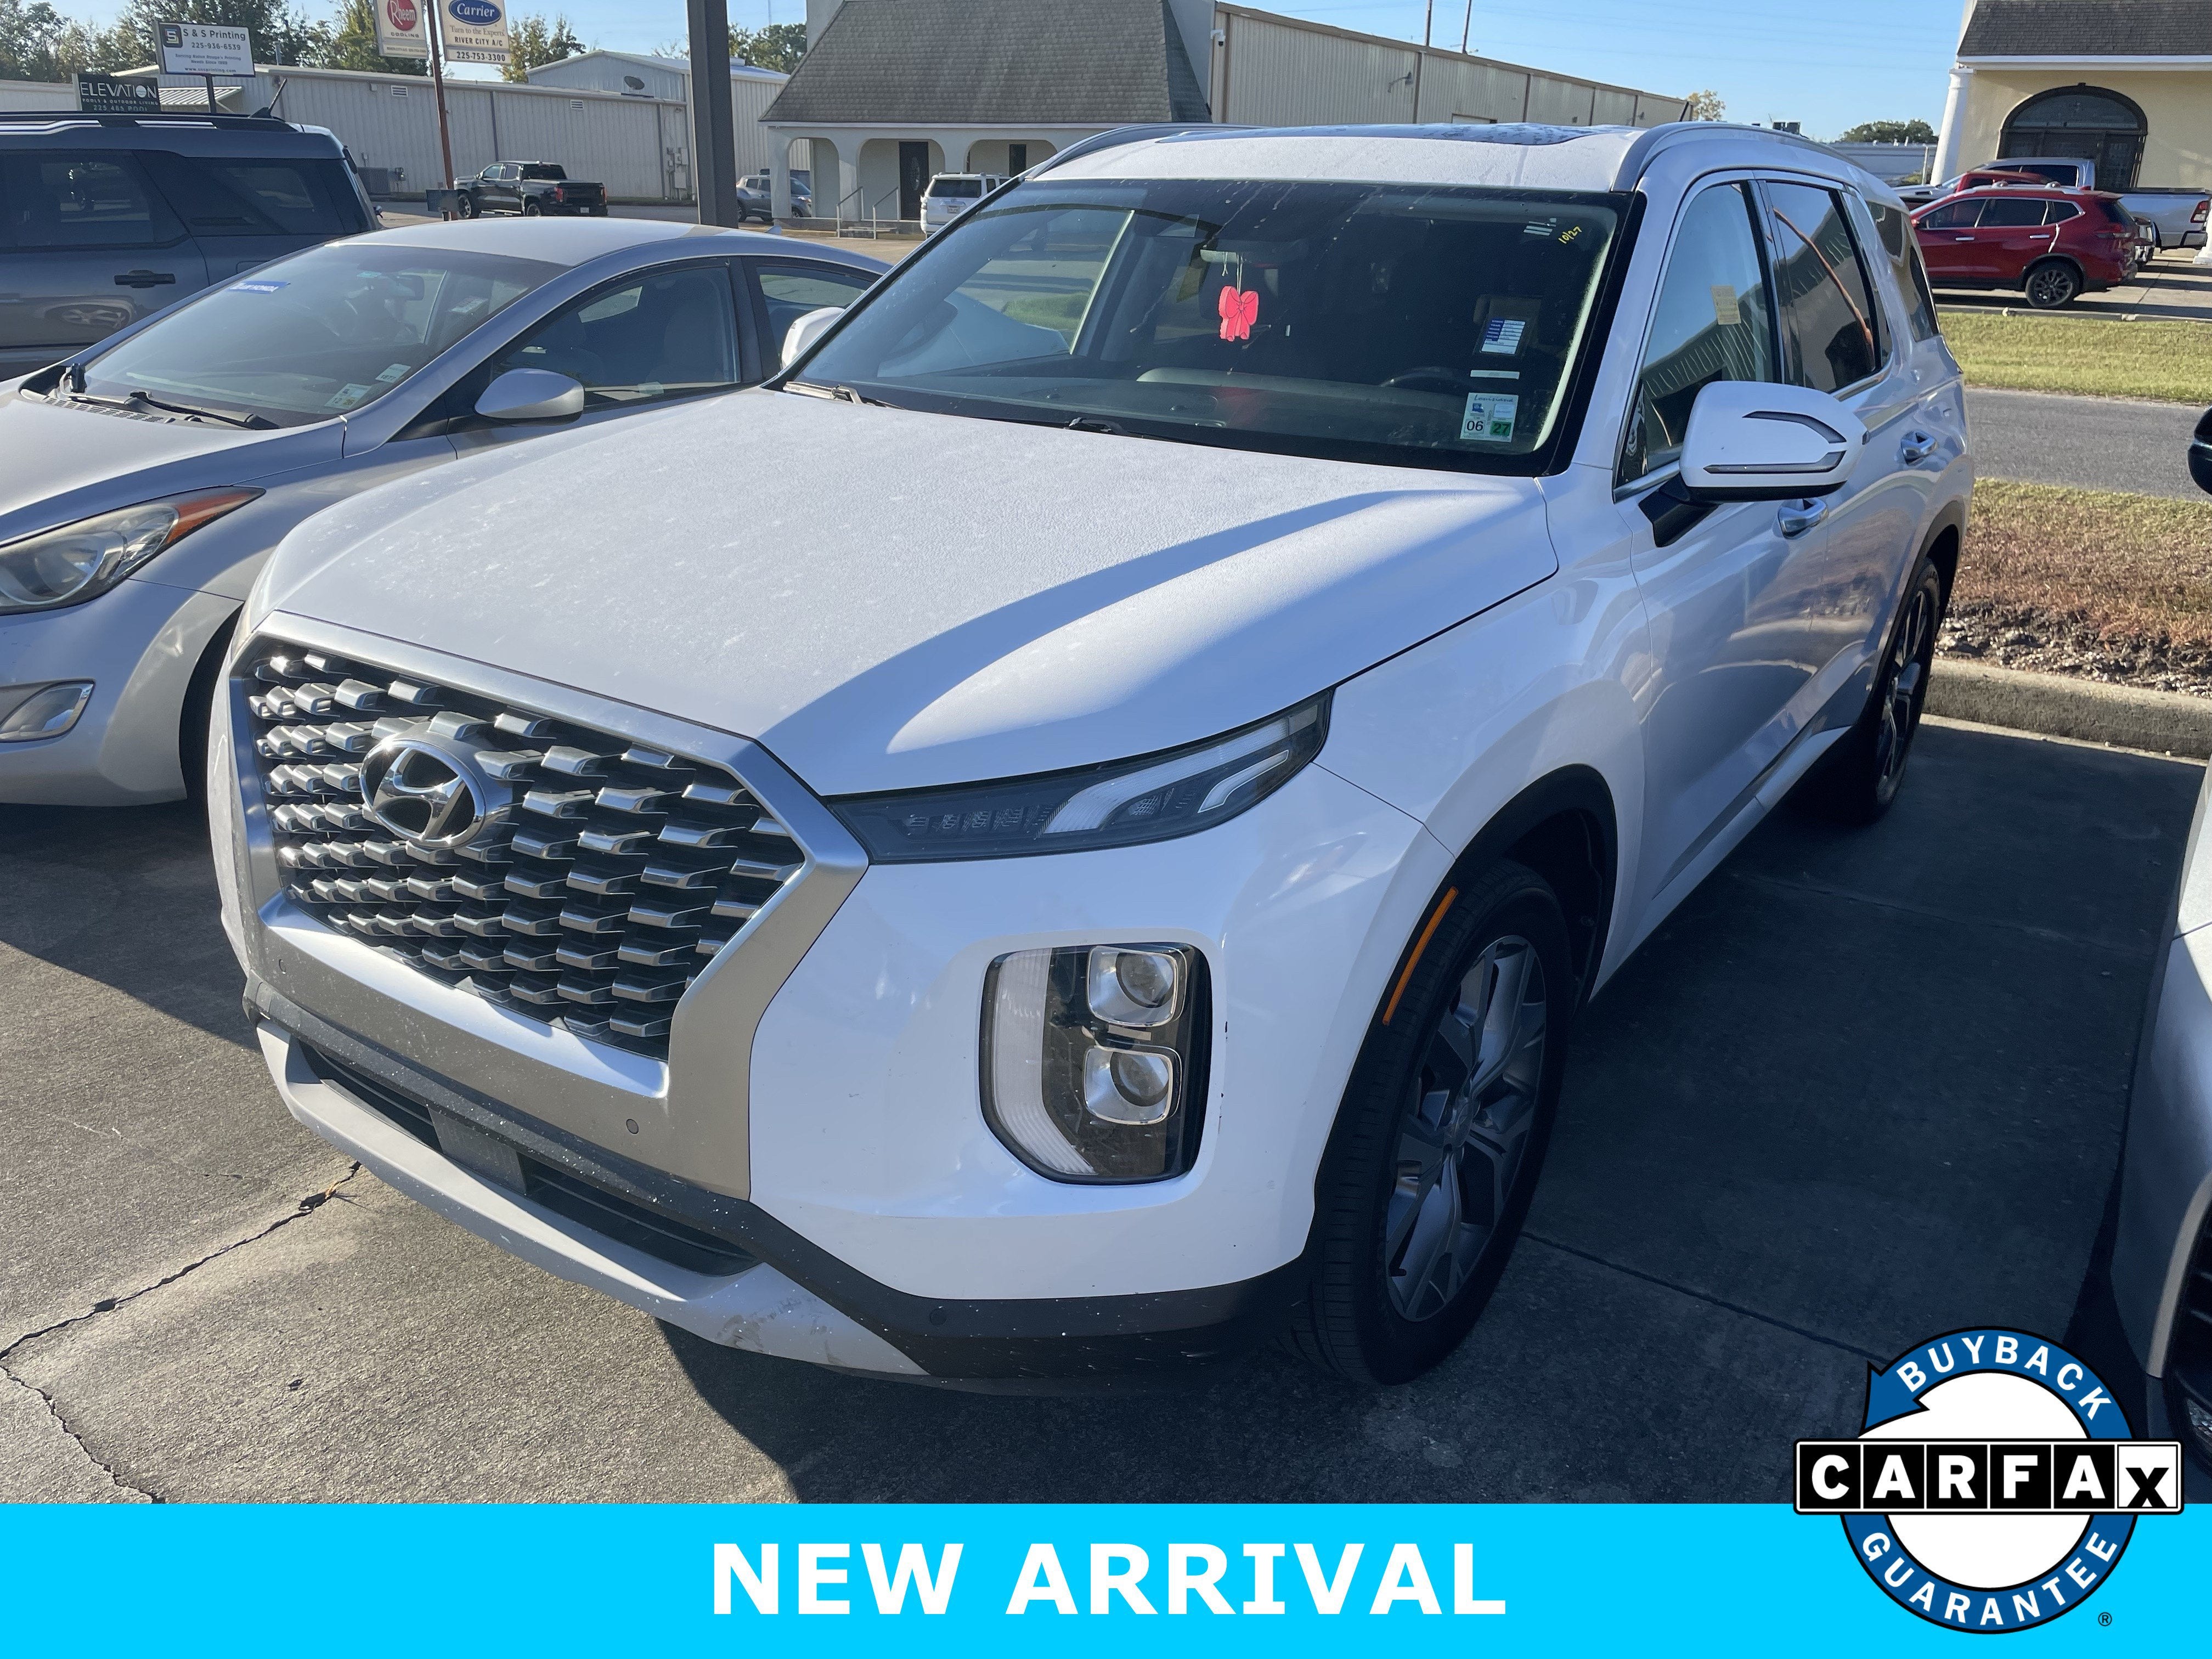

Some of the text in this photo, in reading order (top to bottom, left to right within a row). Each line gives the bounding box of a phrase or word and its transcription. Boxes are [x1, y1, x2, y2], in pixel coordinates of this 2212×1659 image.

[390, 0, 416, 25] Rheem
[457, 3, 495, 17] Carrier
[210, 30, 246, 41] Printing
[191, 42, 241, 50] 225-936-6539
[456, 51, 505, 61] 225-753-3300
[80, 82, 157, 98] ELEVATION
[1558, 225, 1582, 244] 10/27
[1466, 420, 1510, 436] 06 27
